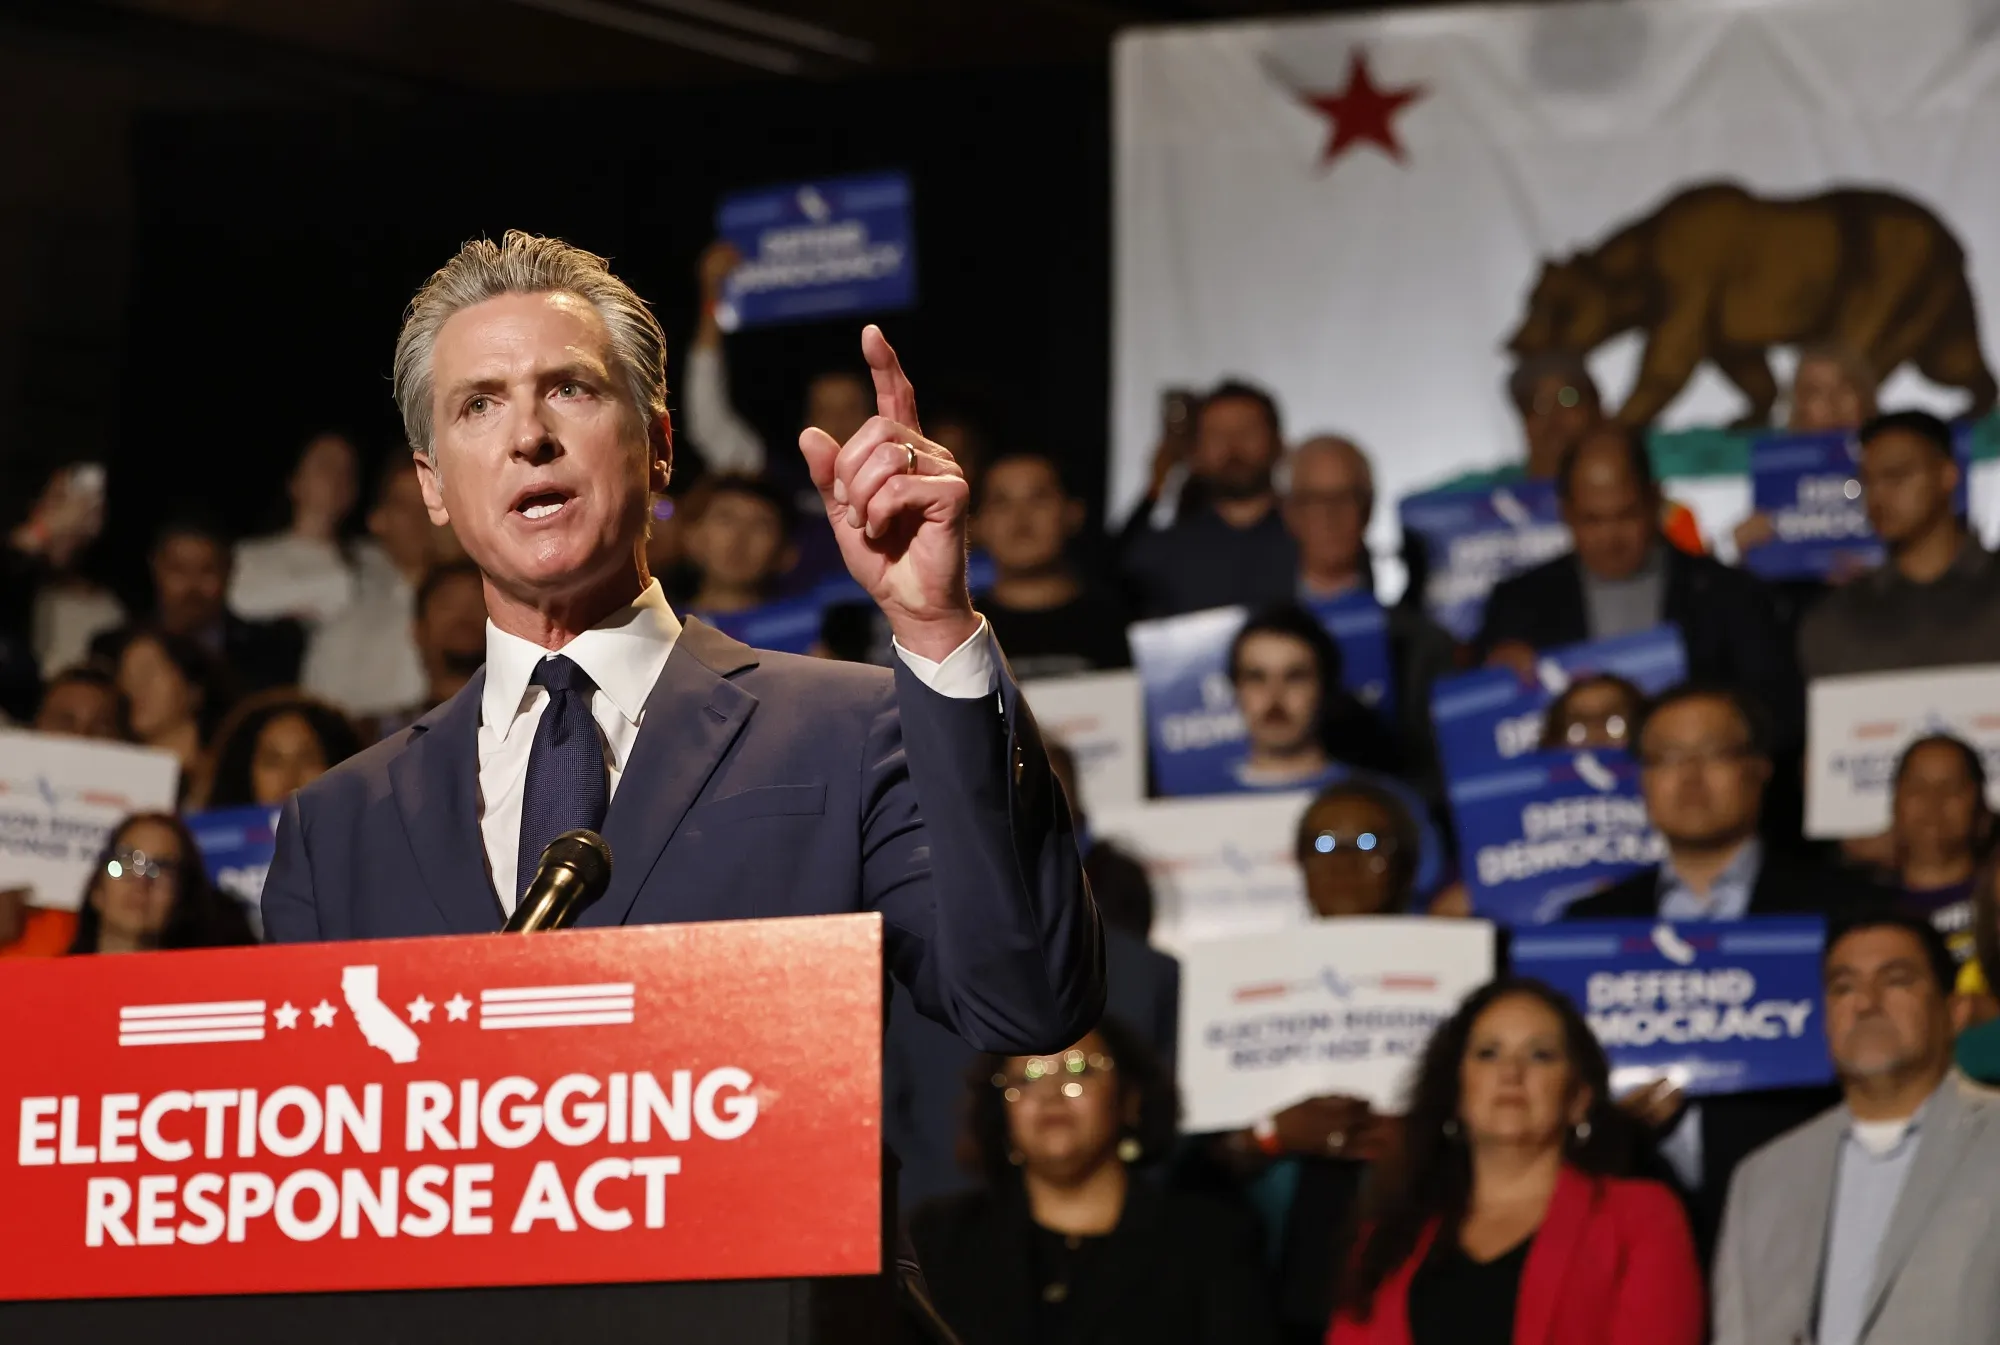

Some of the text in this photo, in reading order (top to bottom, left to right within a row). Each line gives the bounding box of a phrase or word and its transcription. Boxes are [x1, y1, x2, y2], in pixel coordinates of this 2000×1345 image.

[1586, 968, 1756, 1010] DEFEND
[1587, 1000, 1812, 1046] MOCRACY
[19, 1067, 761, 1166] ELECTION RIGGING
[86, 1157, 681, 1247] RESPONSE ACT
